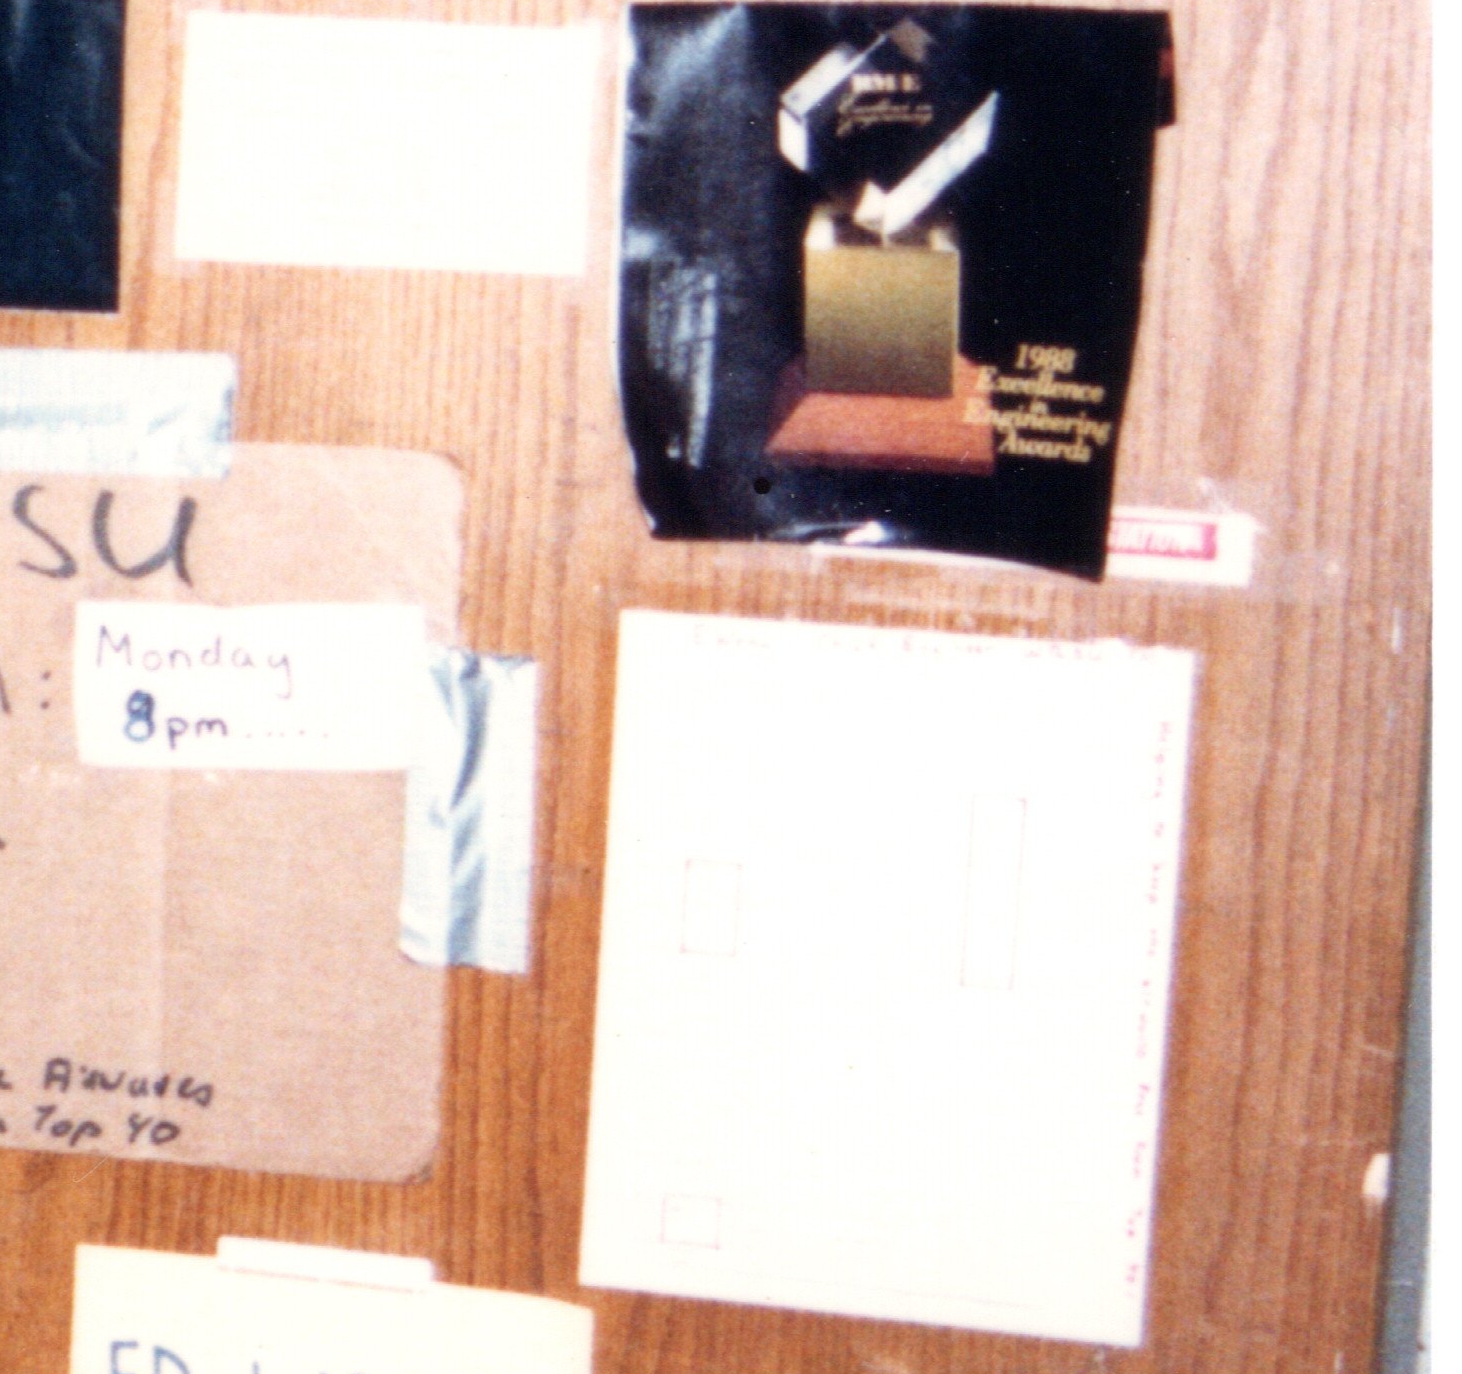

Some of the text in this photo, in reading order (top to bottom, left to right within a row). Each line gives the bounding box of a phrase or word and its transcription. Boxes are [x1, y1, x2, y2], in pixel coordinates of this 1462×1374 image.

[1015, 343, 1076, 373] 1988
[973, 365, 1105, 404] Excellence
[963, 397, 1113, 447] Engineering
[997, 427, 1092, 464] Awards
[96, 624, 292, 701] Monday
[43, 1057, 214, 1107] Airwaves
[34, 1103, 102, 1148] Top
[127, 1111, 181, 1145] 40
